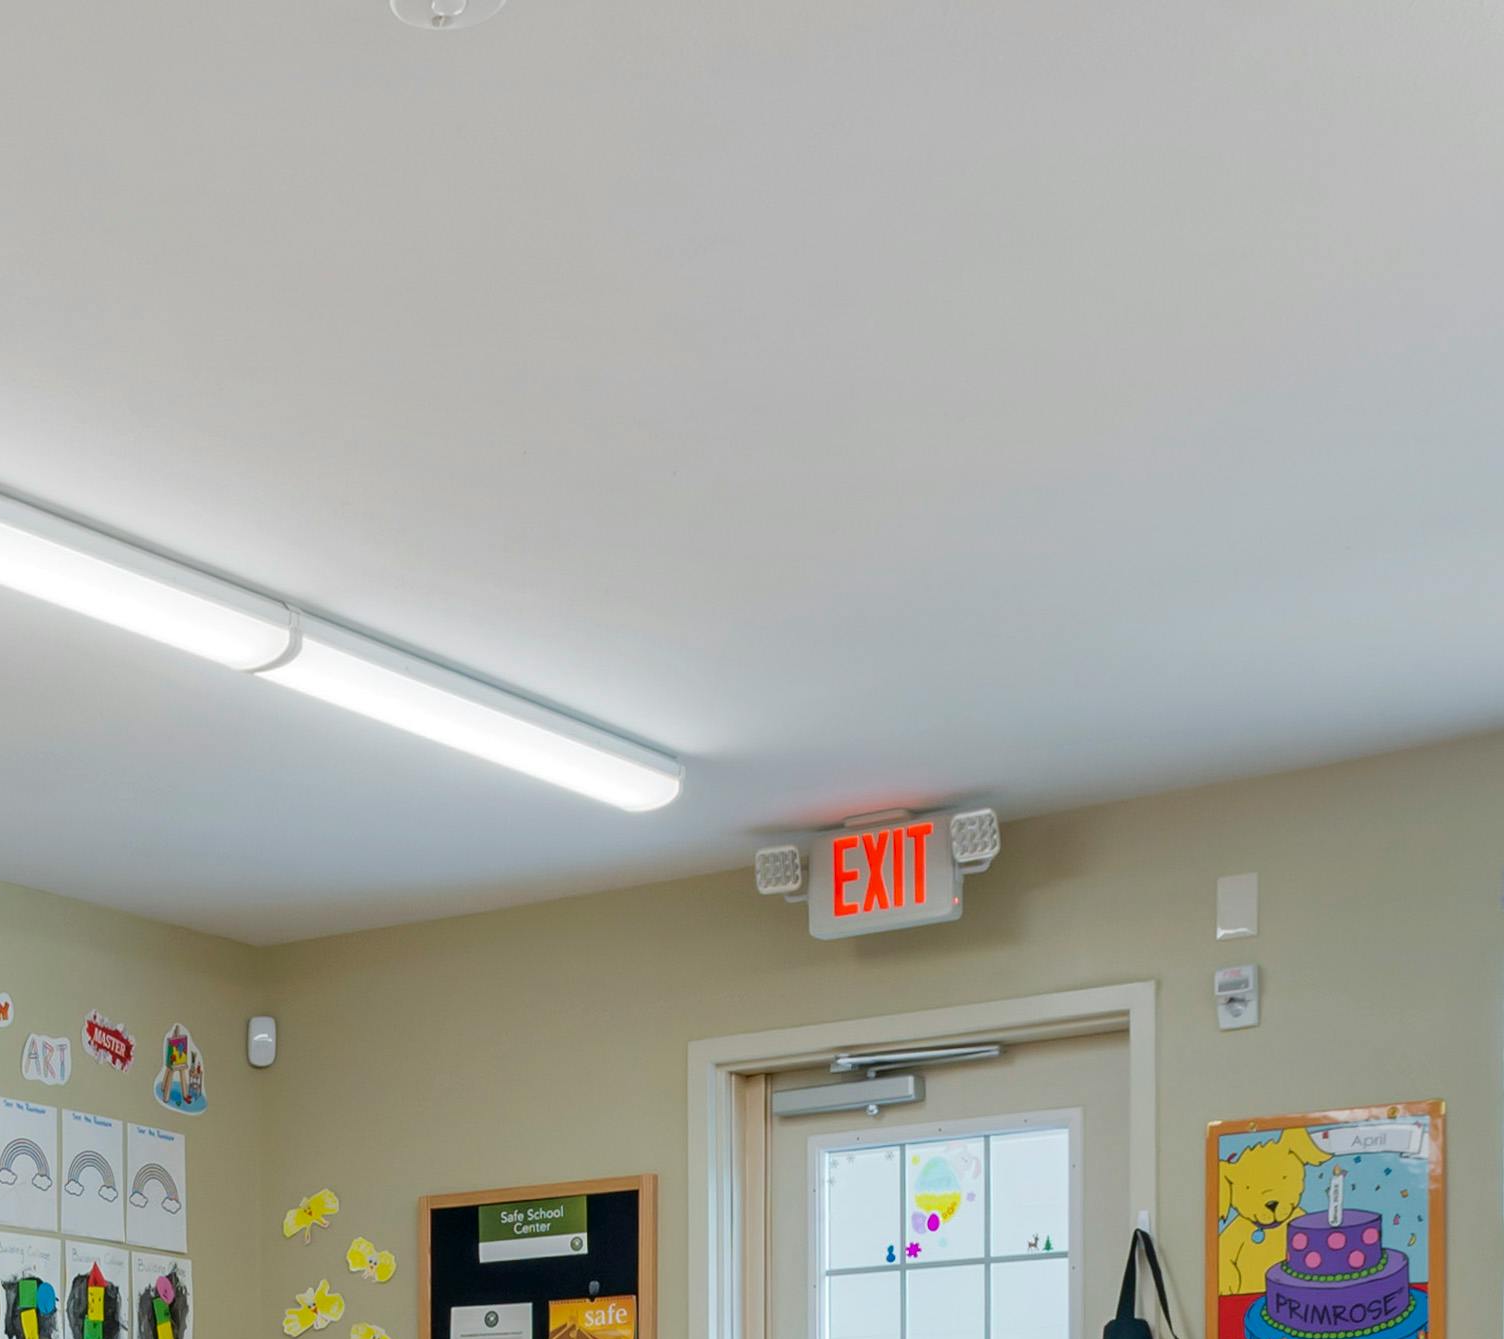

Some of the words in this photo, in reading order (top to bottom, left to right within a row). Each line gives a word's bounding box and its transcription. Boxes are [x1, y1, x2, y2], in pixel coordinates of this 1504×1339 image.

[833, 822, 934, 918] EXIT
[92, 1026, 127, 1058] MASTER
[24, 1037, 69, 1081] ART
[1350, 1132, 1387, 1150] April
[500, 1209, 525, 1224] Safe
[527, 1205, 564, 1221] School
[513, 1221, 551, 1235] Center
[584, 1302, 628, 1328] safe
[1275, 1291, 1399, 1326] PRIMROSE
